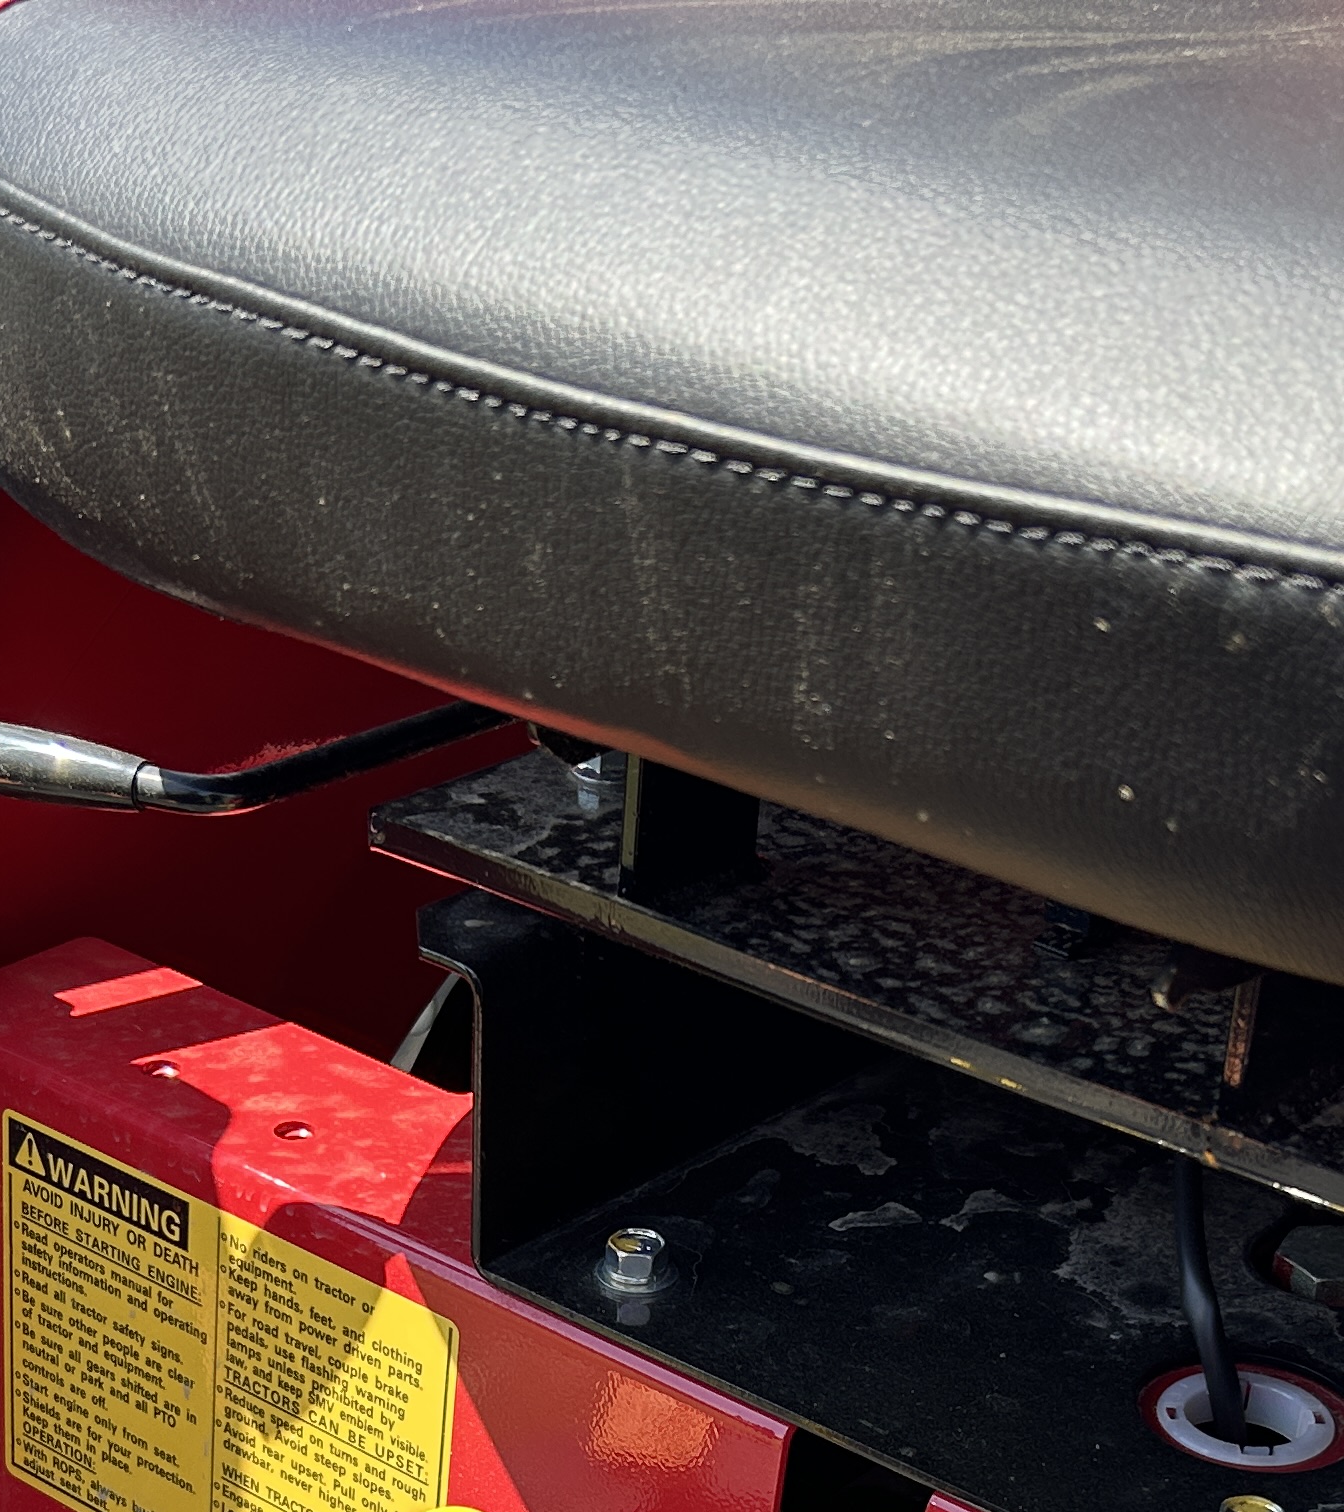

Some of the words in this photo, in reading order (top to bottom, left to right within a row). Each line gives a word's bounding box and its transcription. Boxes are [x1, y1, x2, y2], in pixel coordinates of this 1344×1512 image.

[21, 1200, 70, 1237] BEFORE
[75, 1227, 141, 1272] STARTING
[22, 1178, 64, 1210] AVOID
[69, 1199, 121, 1238] INJURY
[126, 1228, 147, 1252] OR
[153, 1240, 200, 1278] DEATH
[47, 1152, 182, 1242] WARNING
[21, 1221, 49, 1247] Read
[52, 1241, 106, 1276] operators
[110, 1269, 153, 1299] manual
[156, 1290, 174, 1310] for
[21, 1251, 88, 1298] instructions.
[21, 1239, 54, 1267] safety
[58, 1255, 122, 1300] information
[126, 1293, 148, 1313] and
[153, 1307, 208, 1345] operating
[228, 1254, 297, 1296] equipment.
[229, 1234, 249, 1258] No
[252, 1246, 287, 1274] riders
[292, 1268, 309, 1285] on
[313, 1276, 357, 1307] tractor
[361, 1302, 376, 1316] or
[21, 1270, 49, 1296] Read
[53, 1289, 67, 1305] all
[70, 1297, 108, 1326] tractor
[112, 1320, 146, 1348] safety
[150, 1339, 184, 1366] signs.
[21, 1289, 36, 1308] Be
[40, 1301, 64, 1322] sure
[68, 1316, 98, 1339] other
[102, 1333, 140, 1362] people
[144, 1356, 163, 1373] are
[167, 1368, 196, 1390] clear
[21, 1307, 34, 1320] of
[36, 1313, 74, 1341] tractor
[78, 1336, 99, 1355] and
[103, 1349, 166, 1391] equipment.
[227, 1285, 260, 1312] away
[264, 1300, 293, 1326] from
[298, 1320, 339, 1348] power
[342, 1340, 382, 1370] driven
[387, 1364, 423, 1391] parts.
[227, 1301, 247, 1323] For
[251, 1317, 280, 1340] road
[327, 1355, 369, 1384] couple
[375, 1375, 409, 1404] brake
[228, 1265, 258, 1293] Keep
[342, 1325, 366, 1345] and
[371, 1339, 423, 1375] clothing
[21, 1321, 36, 1340] Be
[40, 1335, 64, 1355] sure
[68, 1349, 82, 1364] all
[86, 1359, 116, 1382] gears
[120, 1376, 159, 1405] shifted
[163, 1400, 181, 1417] are
[186, 1408, 197, 1426] in
[22, 1358, 65, 1388] controls
[69, 1383, 87, 1400] are
[22, 1339, 60, 1368] neutral
[64, 1362, 77, 1375] or
[80, 1370, 105, 1392] park
[109, 1385, 130, 1405] and
[134, 1399, 149, 1415] all
[153, 1405, 177, 1429] PTO
[226, 1332, 262, 1363] lamps
[267, 1356, 306, 1385] unless
[311, 1379, 374, 1420] prohibited
[380, 1410, 396, 1431] by
[251, 1365, 273, 1384] and
[277, 1374, 304, 1400] keep
[307, 1390, 335, 1414] SMV
[339, 1410, 384, 1441] emblem
[390, 1435, 428, 1463] visible.
[274, 1344, 296, 1364] use
[300, 1354, 349, 1392] flashing
[355, 1384, 406, 1421] warning
[22, 1372, 49, 1398] Start
[53, 1392, 90, 1419] engine
[94, 1414, 118, 1436] only
[122, 1426, 149, 1451] from
[153, 1446, 181, 1469] seat.
[22, 1404, 49, 1430] Keep
[52, 1422, 82, 1447] them
[101, 1450, 133, 1475] place.
[22, 1390, 61, 1422] Shields
[65, 1417, 83, 1434] are
[86, 1425, 103, 1444] for
[106, 1438, 132, 1460] your
[136, 1455, 196, 1495] protection.
[22, 1420, 96, 1471] OPERATION:
[22, 1439, 48, 1464] With
[52, 1455, 86, 1485] ROPS,
[222, 1421, 256, 1449] Avoid
[262, 1443, 286, 1464] rear
[333, 1478, 356, 1501] Pull
[223, 1364, 301, 1416] TRACTORS
[308, 1409, 340, 1436] CAN
[347, 1429, 367, 1450] BE
[375, 1442, 428, 1483] UPSET:
[224, 1386, 266, 1419] Reduce
[270, 1413, 304, 1439] speed
[309, 1434, 324, 1450] on
[329, 1442, 359, 1468] turns
[364, 1462, 386, 1482] and
[391, 1476, 426, 1503] rough
[23, 1456, 56, 1482] adjust
[59, 1476, 82, 1497] seat
[221, 1462, 260, 1494] WHEN
[222, 1437, 274, 1474] drawbar,
[280, 1469, 313, 1494] never
[274, 1429, 308, 1457] Avoid
[313, 1452, 347, 1477] steep
[352, 1471, 395, 1502] slopes.
